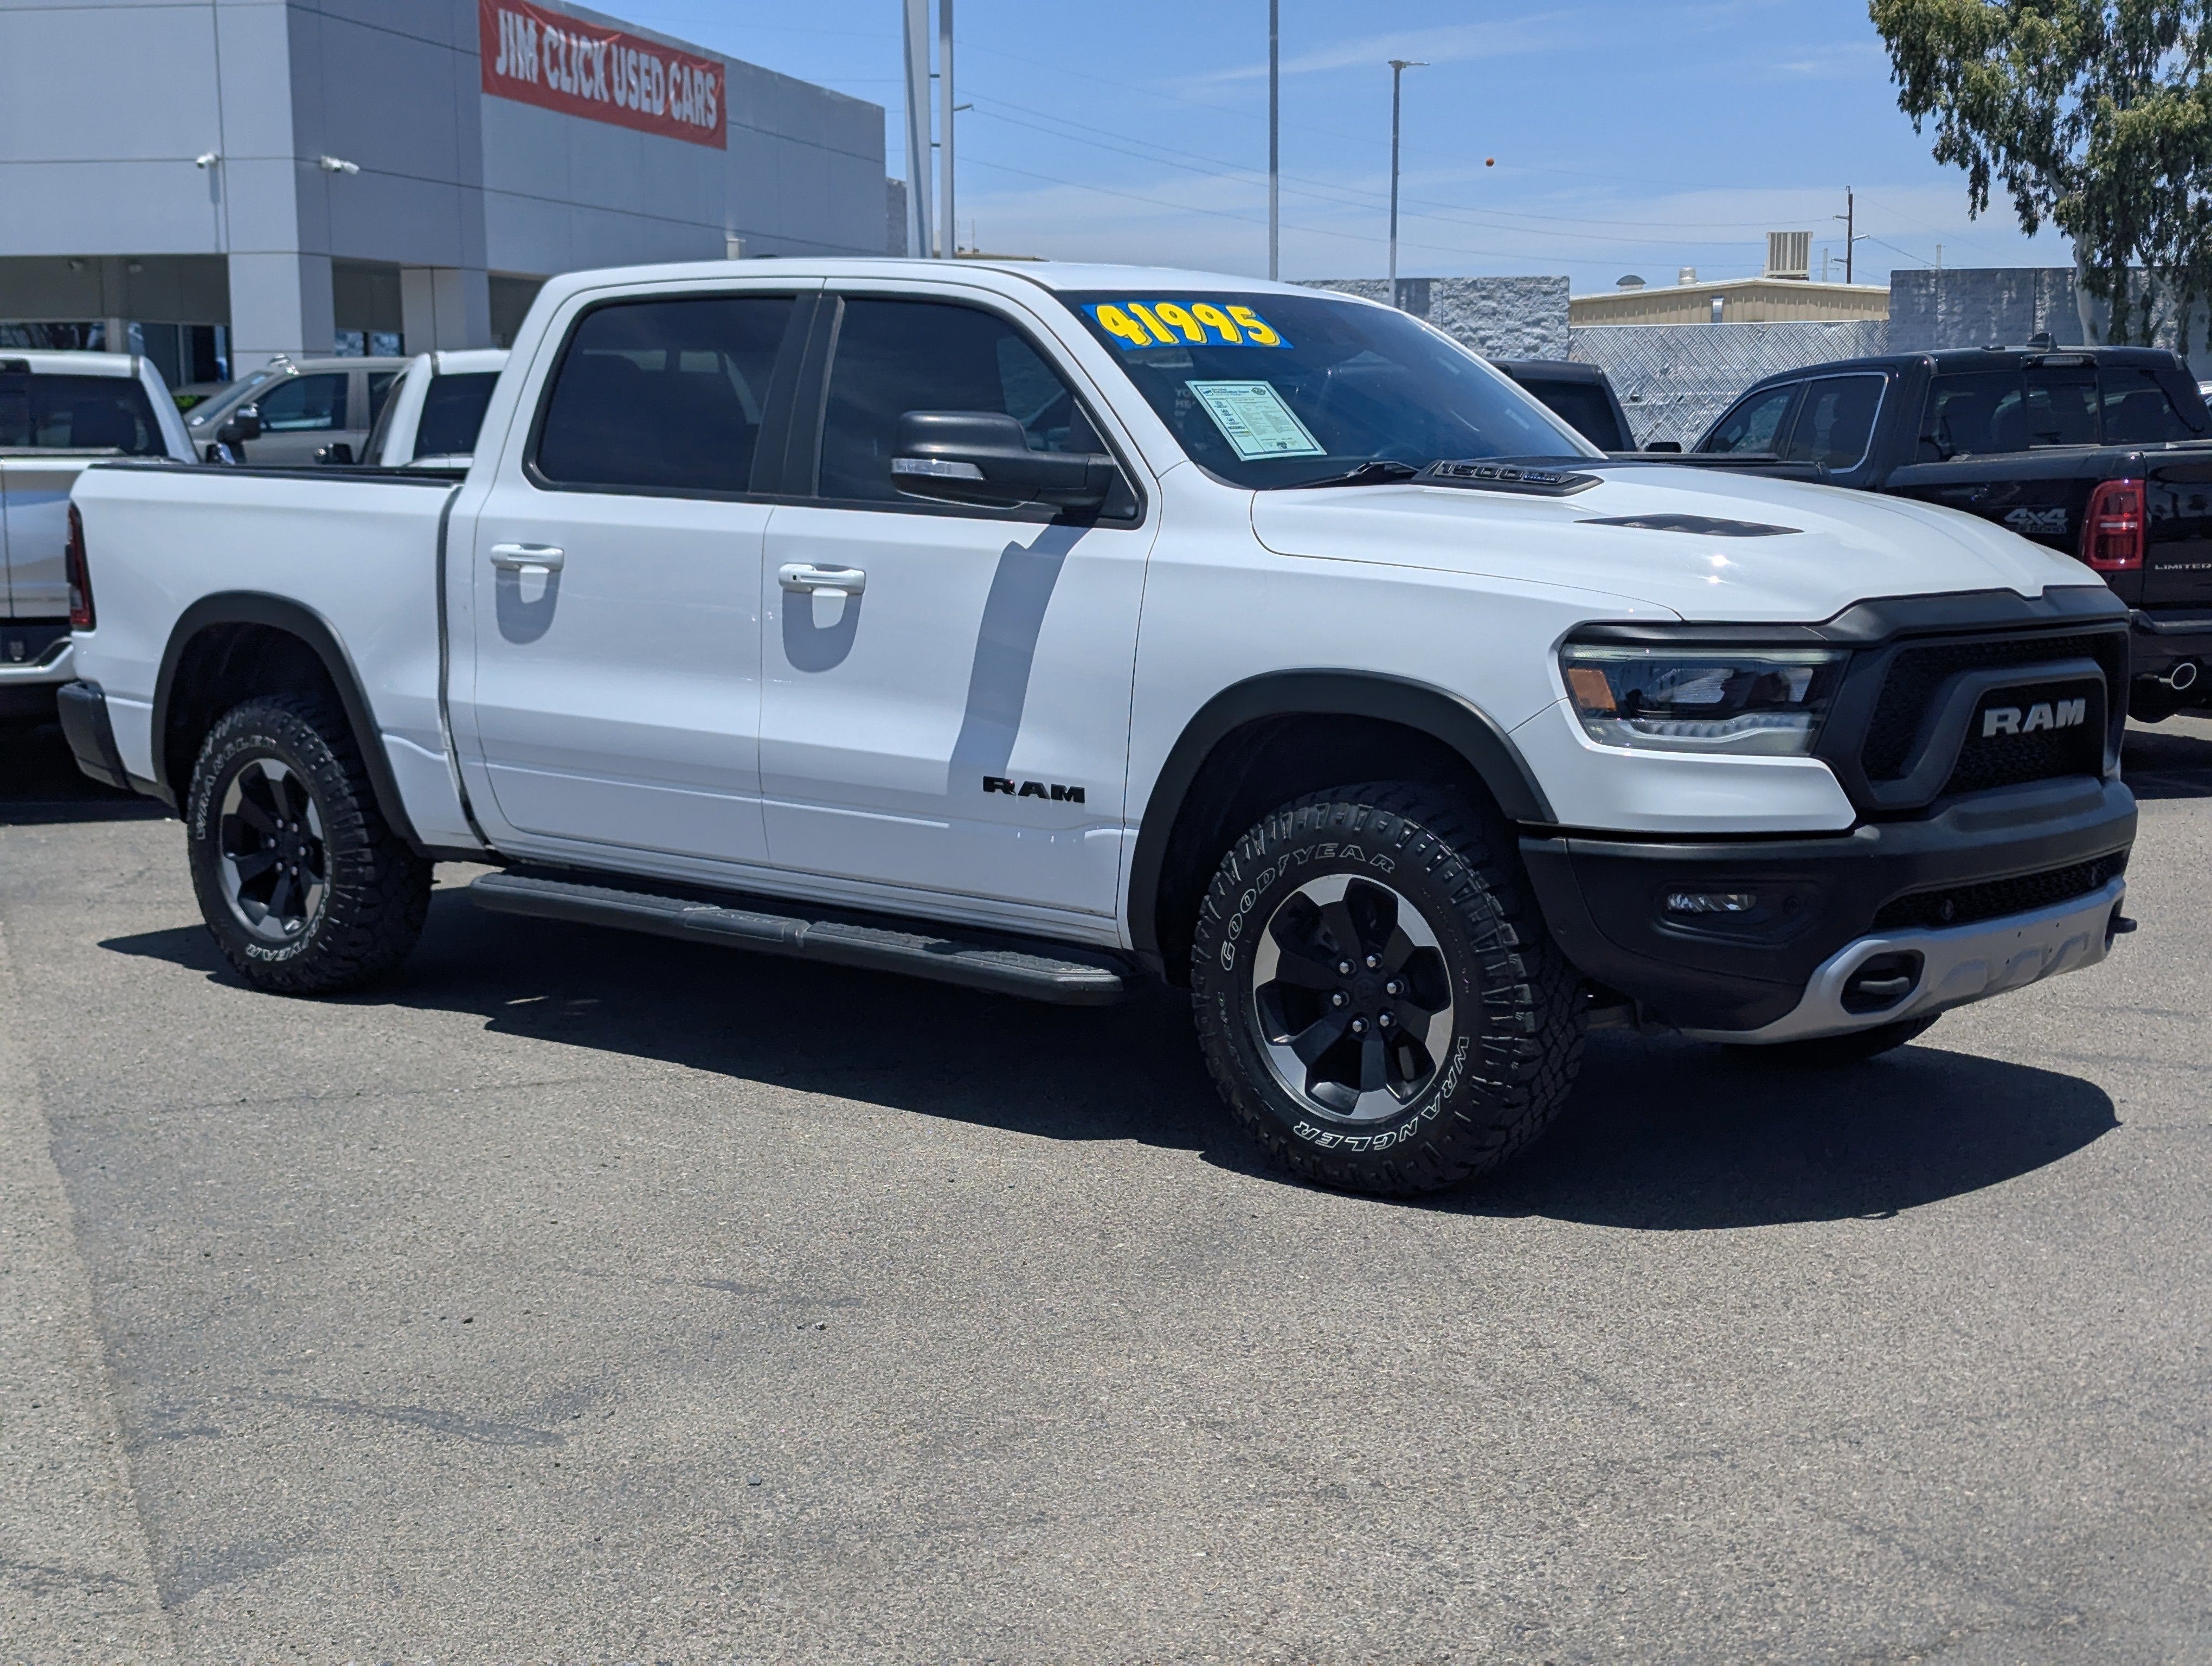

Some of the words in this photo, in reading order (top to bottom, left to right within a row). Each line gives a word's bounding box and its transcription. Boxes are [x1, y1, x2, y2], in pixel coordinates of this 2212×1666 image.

[496, 9, 539, 84] JIM
[543, 25, 609, 102] CLICK
[611, 44, 665, 116] USED
[668, 61, 717, 130] CARS
[1096, 303, 1281, 346] 41995
[1982, 697, 2086, 738] RAM
[982, 776, 1085, 804] RAM
[1221, 843, 1396, 971] GOODYEAR
[1293, 1036, 1470, 1152] WRANGLER
